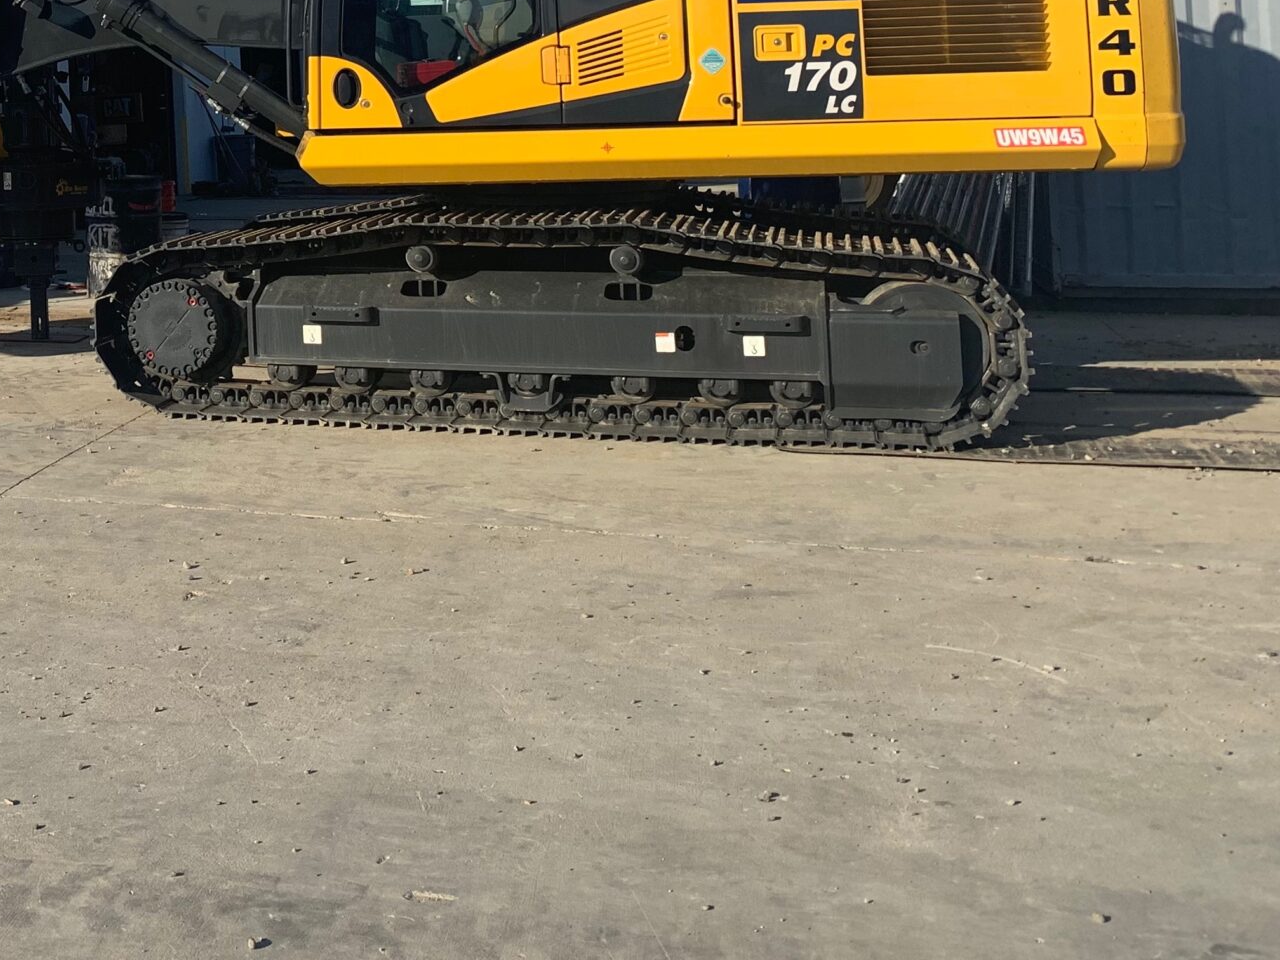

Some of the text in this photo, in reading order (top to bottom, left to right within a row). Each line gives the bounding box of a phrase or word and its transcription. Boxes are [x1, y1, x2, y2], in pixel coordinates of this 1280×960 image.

[812, 33, 856, 57] PC
[784, 60, 857, 92] 170
[825, 94, 858, 114] LC
[996, 127, 1085, 147] UW9W45
